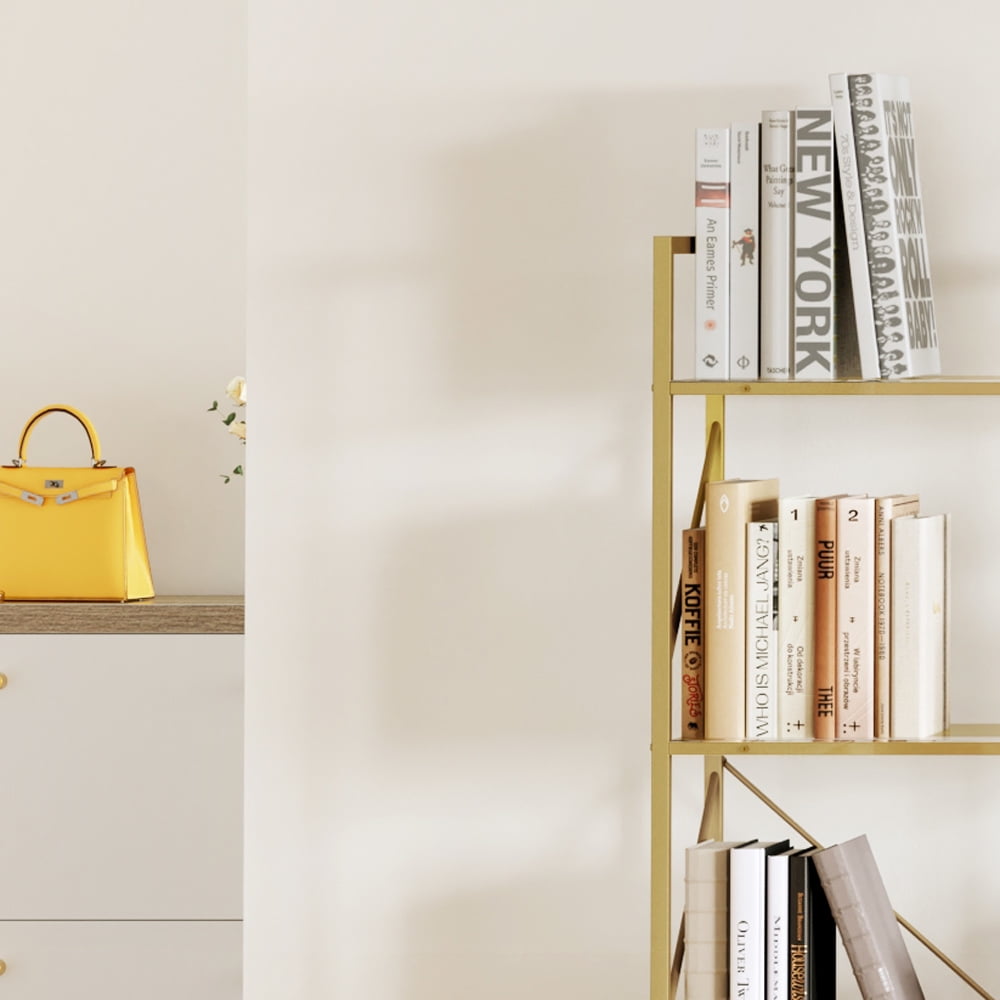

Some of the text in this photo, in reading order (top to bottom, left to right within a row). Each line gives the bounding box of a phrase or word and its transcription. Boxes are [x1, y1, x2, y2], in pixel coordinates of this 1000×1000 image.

[763, 164, 779, 173] What
[842, 156, 855, 190] Style
[887, 137, 919, 196] ONLY
[772, 186, 785, 198] Say
[796, 109, 832, 375] NEW YORK
[847, 200, 861, 251] Design
[704, 218, 718, 312] An Eames Primer
[898, 237, 932, 298] ROLL
[904, 300, 938, 349] BABY!
[790, 509, 799, 521] 1
[847, 509, 859, 522] 2
[786, 549, 794, 589] ustawienia
[796, 555, 805, 582] Zmiana
[817, 540, 835, 580] PUUR
[843, 550, 851, 589] ustawienia
[852, 556, 861, 583] Zmiana
[878, 572, 886, 615] NOTEBOOK
[684, 583, 701, 646] KOFFIE
[755, 537, 770, 737] WHO IS MICHAEL JANG?
[851, 647, 861, 693] W labiryncie
[817, 686, 834, 718] THEE
